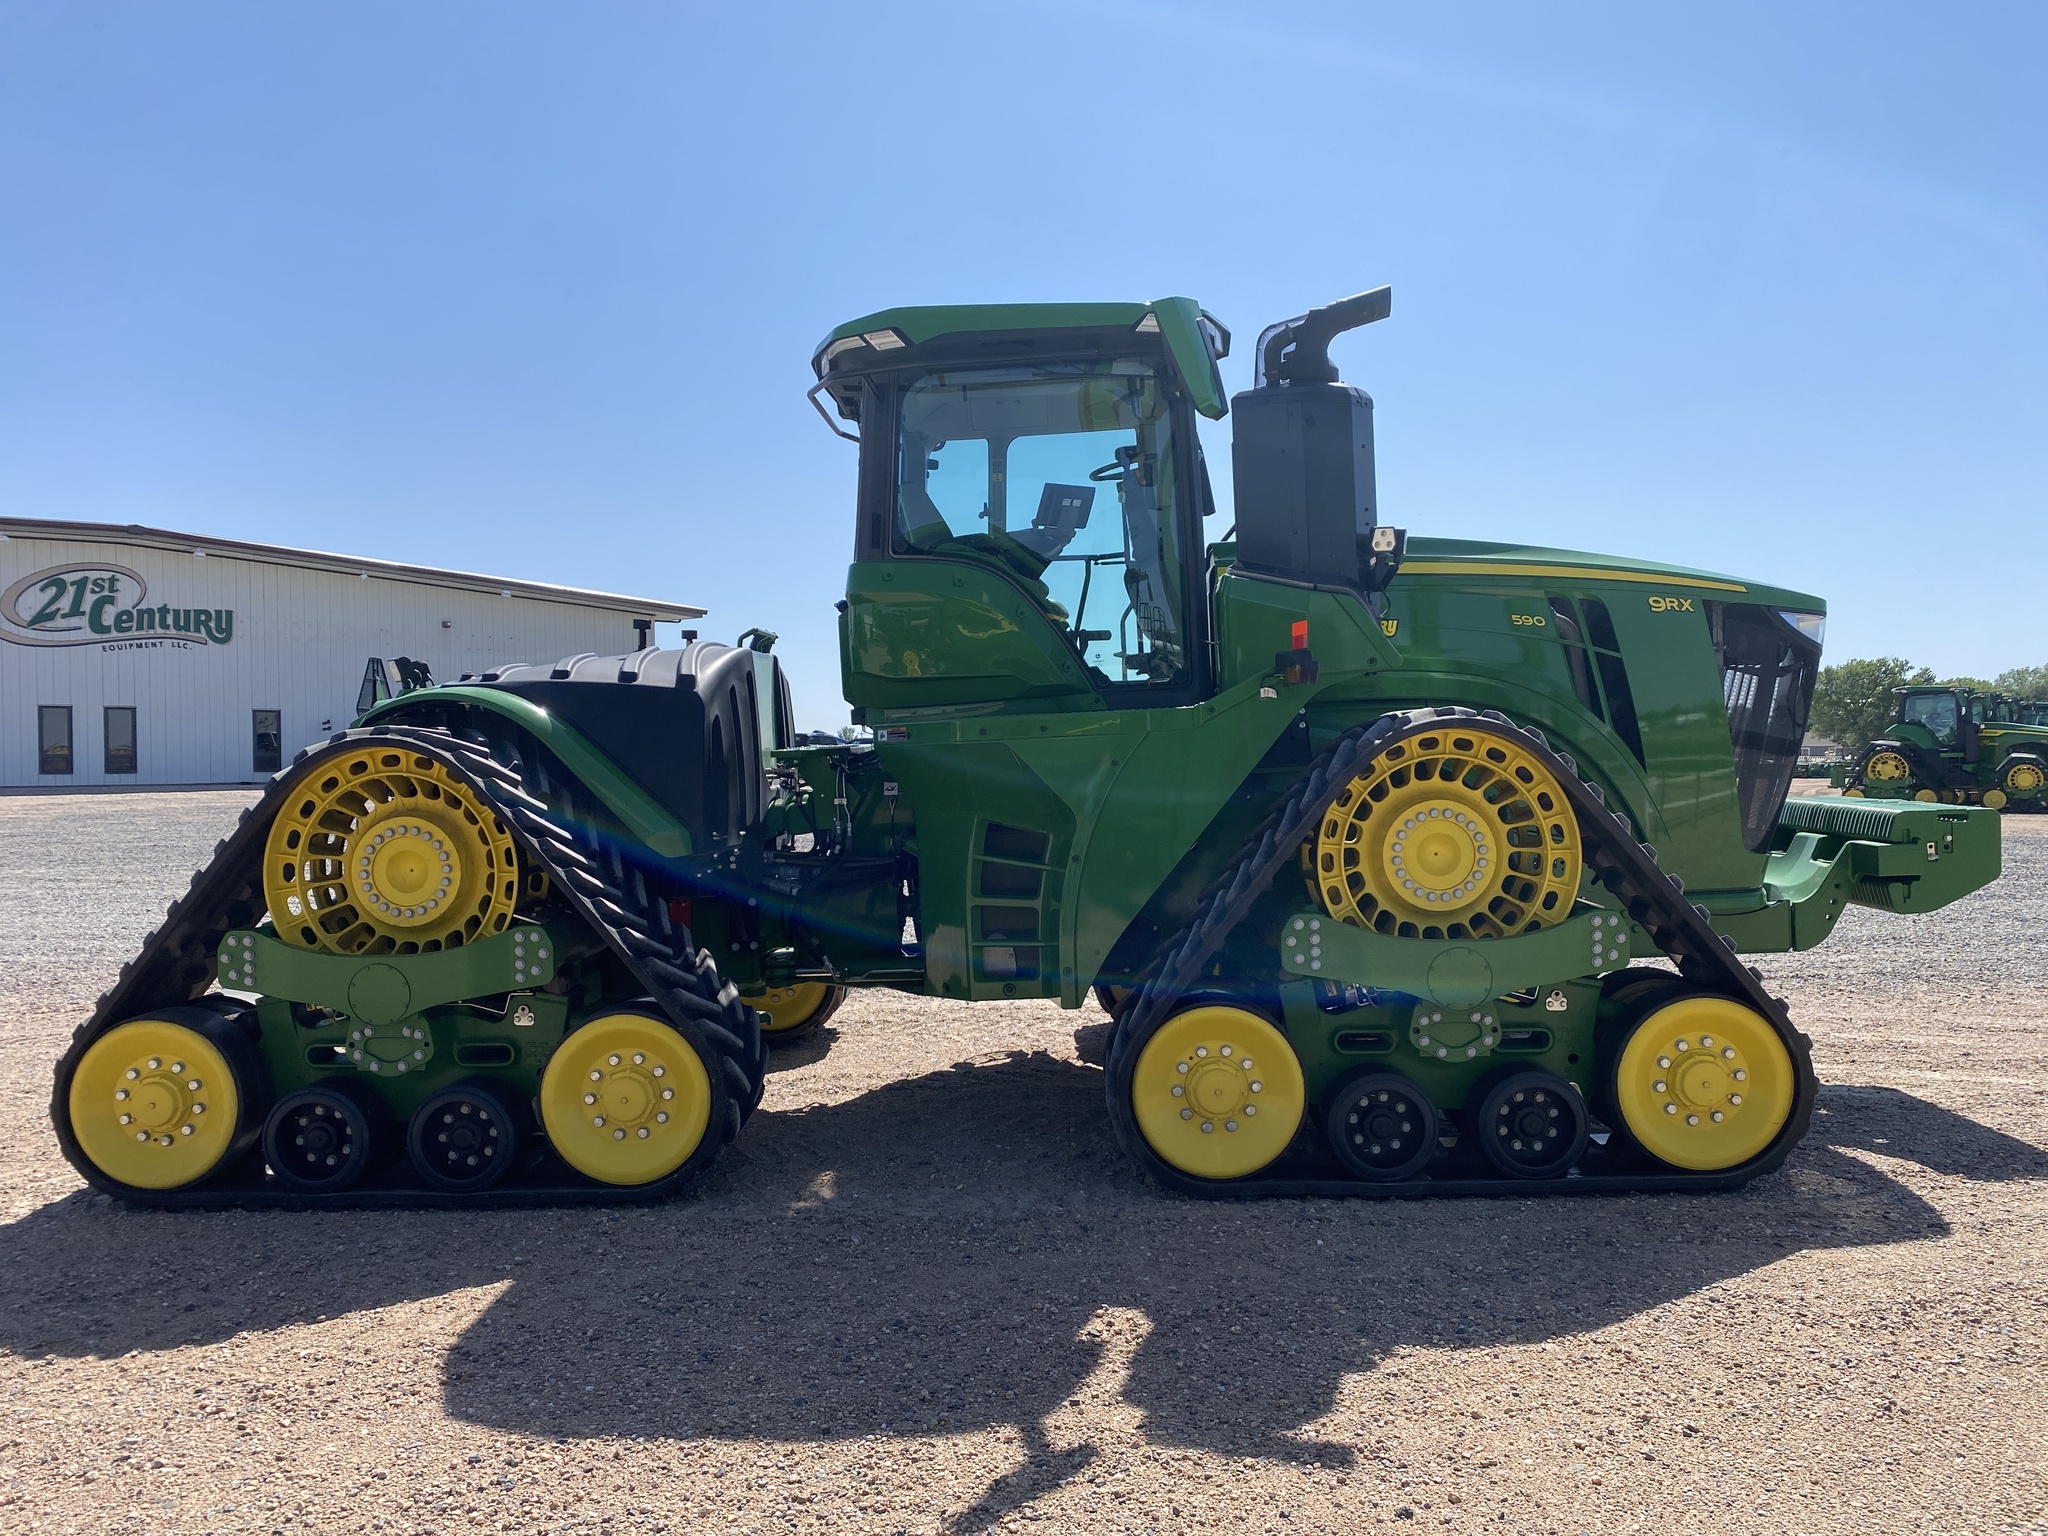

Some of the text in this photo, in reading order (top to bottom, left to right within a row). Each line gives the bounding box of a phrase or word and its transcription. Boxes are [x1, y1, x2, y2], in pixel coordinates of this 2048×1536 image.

[27, 574, 121, 628] 21st
[1648, 596, 1695, 612] 9RX
[1511, 614, 1546, 627] 590
[101, 641, 164, 652] EQUIPMENT
